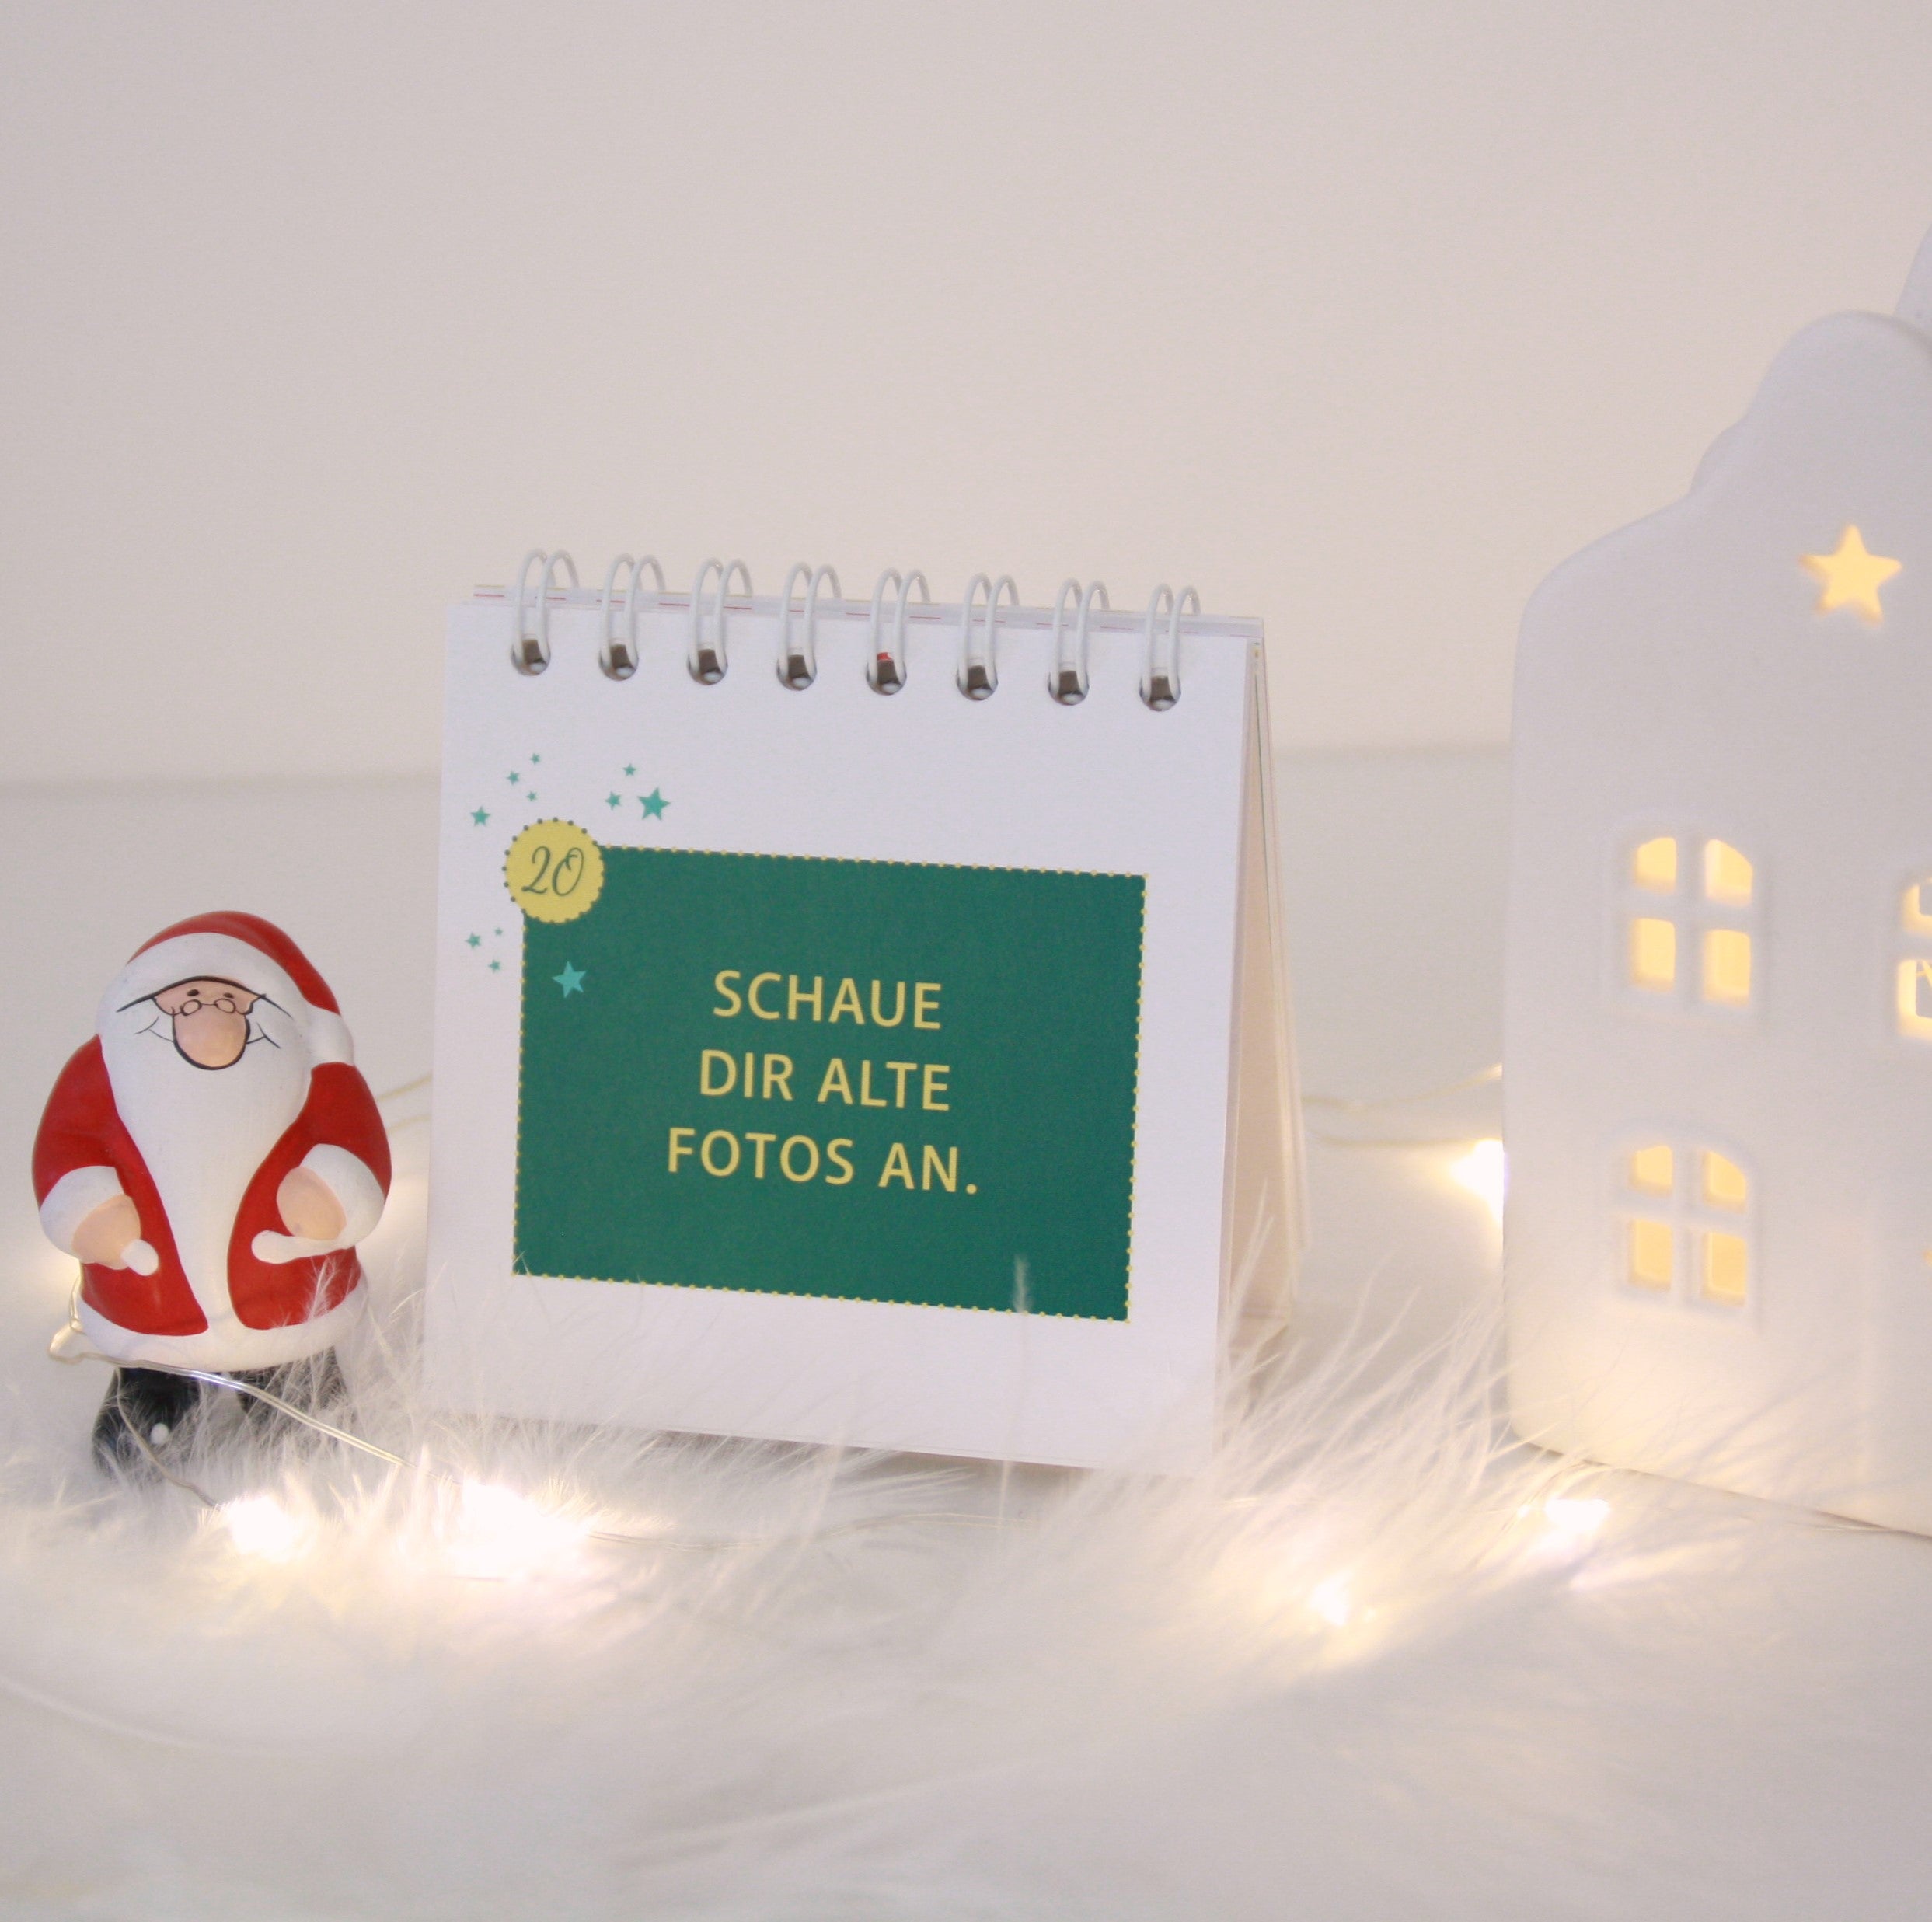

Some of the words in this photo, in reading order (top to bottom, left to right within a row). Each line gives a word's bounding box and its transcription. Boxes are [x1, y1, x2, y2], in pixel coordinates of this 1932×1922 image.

[521, 846, 584, 897] 20
[713, 970, 942, 1030] SCHAUE
[699, 1049, 793, 1101] DIR
[817, 1058, 950, 1111] ALTE
[668, 1127, 854, 1185] FOTOS
[878, 1142, 978, 1195] AN.
